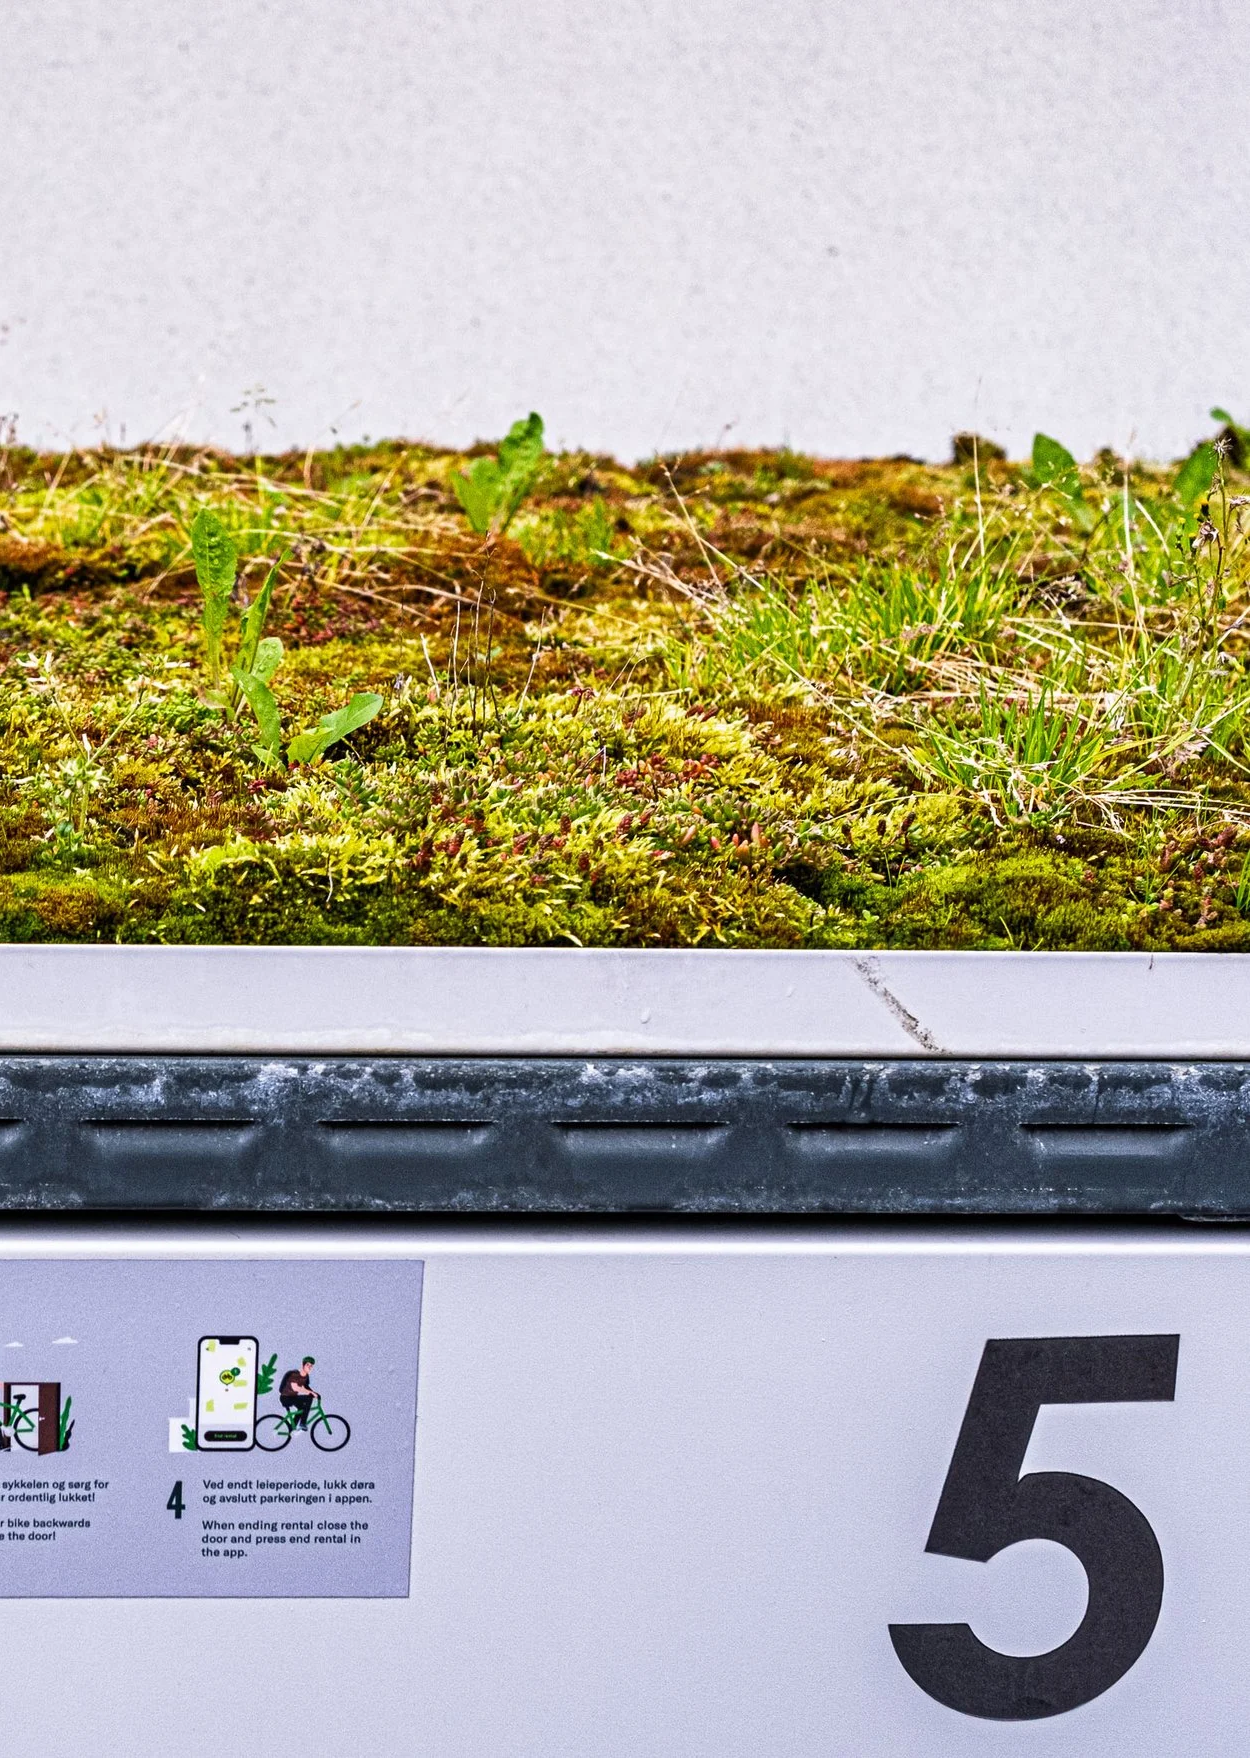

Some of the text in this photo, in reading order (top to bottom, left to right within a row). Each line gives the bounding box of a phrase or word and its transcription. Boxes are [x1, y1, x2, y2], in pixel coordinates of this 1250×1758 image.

[2, 1479, 49, 1491] sykkelen
[52, 1481, 65, 1491] og
[68, 1481, 91, 1491] sørg
[94, 1479, 109, 1489] for
[203, 1479, 375, 1491] Ved endt leieperiode, lukk døra
[8, 1492, 56, 1504] ordentlig
[59, 1492, 95, 1502] lukket!
[166, 1480, 186, 1519] 4
[202, 1495, 216, 1505] og
[219, 1493, 257, 1503] avslutt
[260, 1493, 325, 1505] parkeringen
[335, 1495, 372, 1505] appen.
[7, 1518, 30, 1528] bike
[33, 1518, 91, 1528] backwards
[202, 1520, 369, 1532] When ending rental close the
[887, 1334, 1180, 1721] 5
[8, 1531, 25, 1541] the
[28, 1531, 56, 1541] door!
[201, 1534, 361, 1545] door and press end rental in
[201, 1547, 248, 1559] the app.
